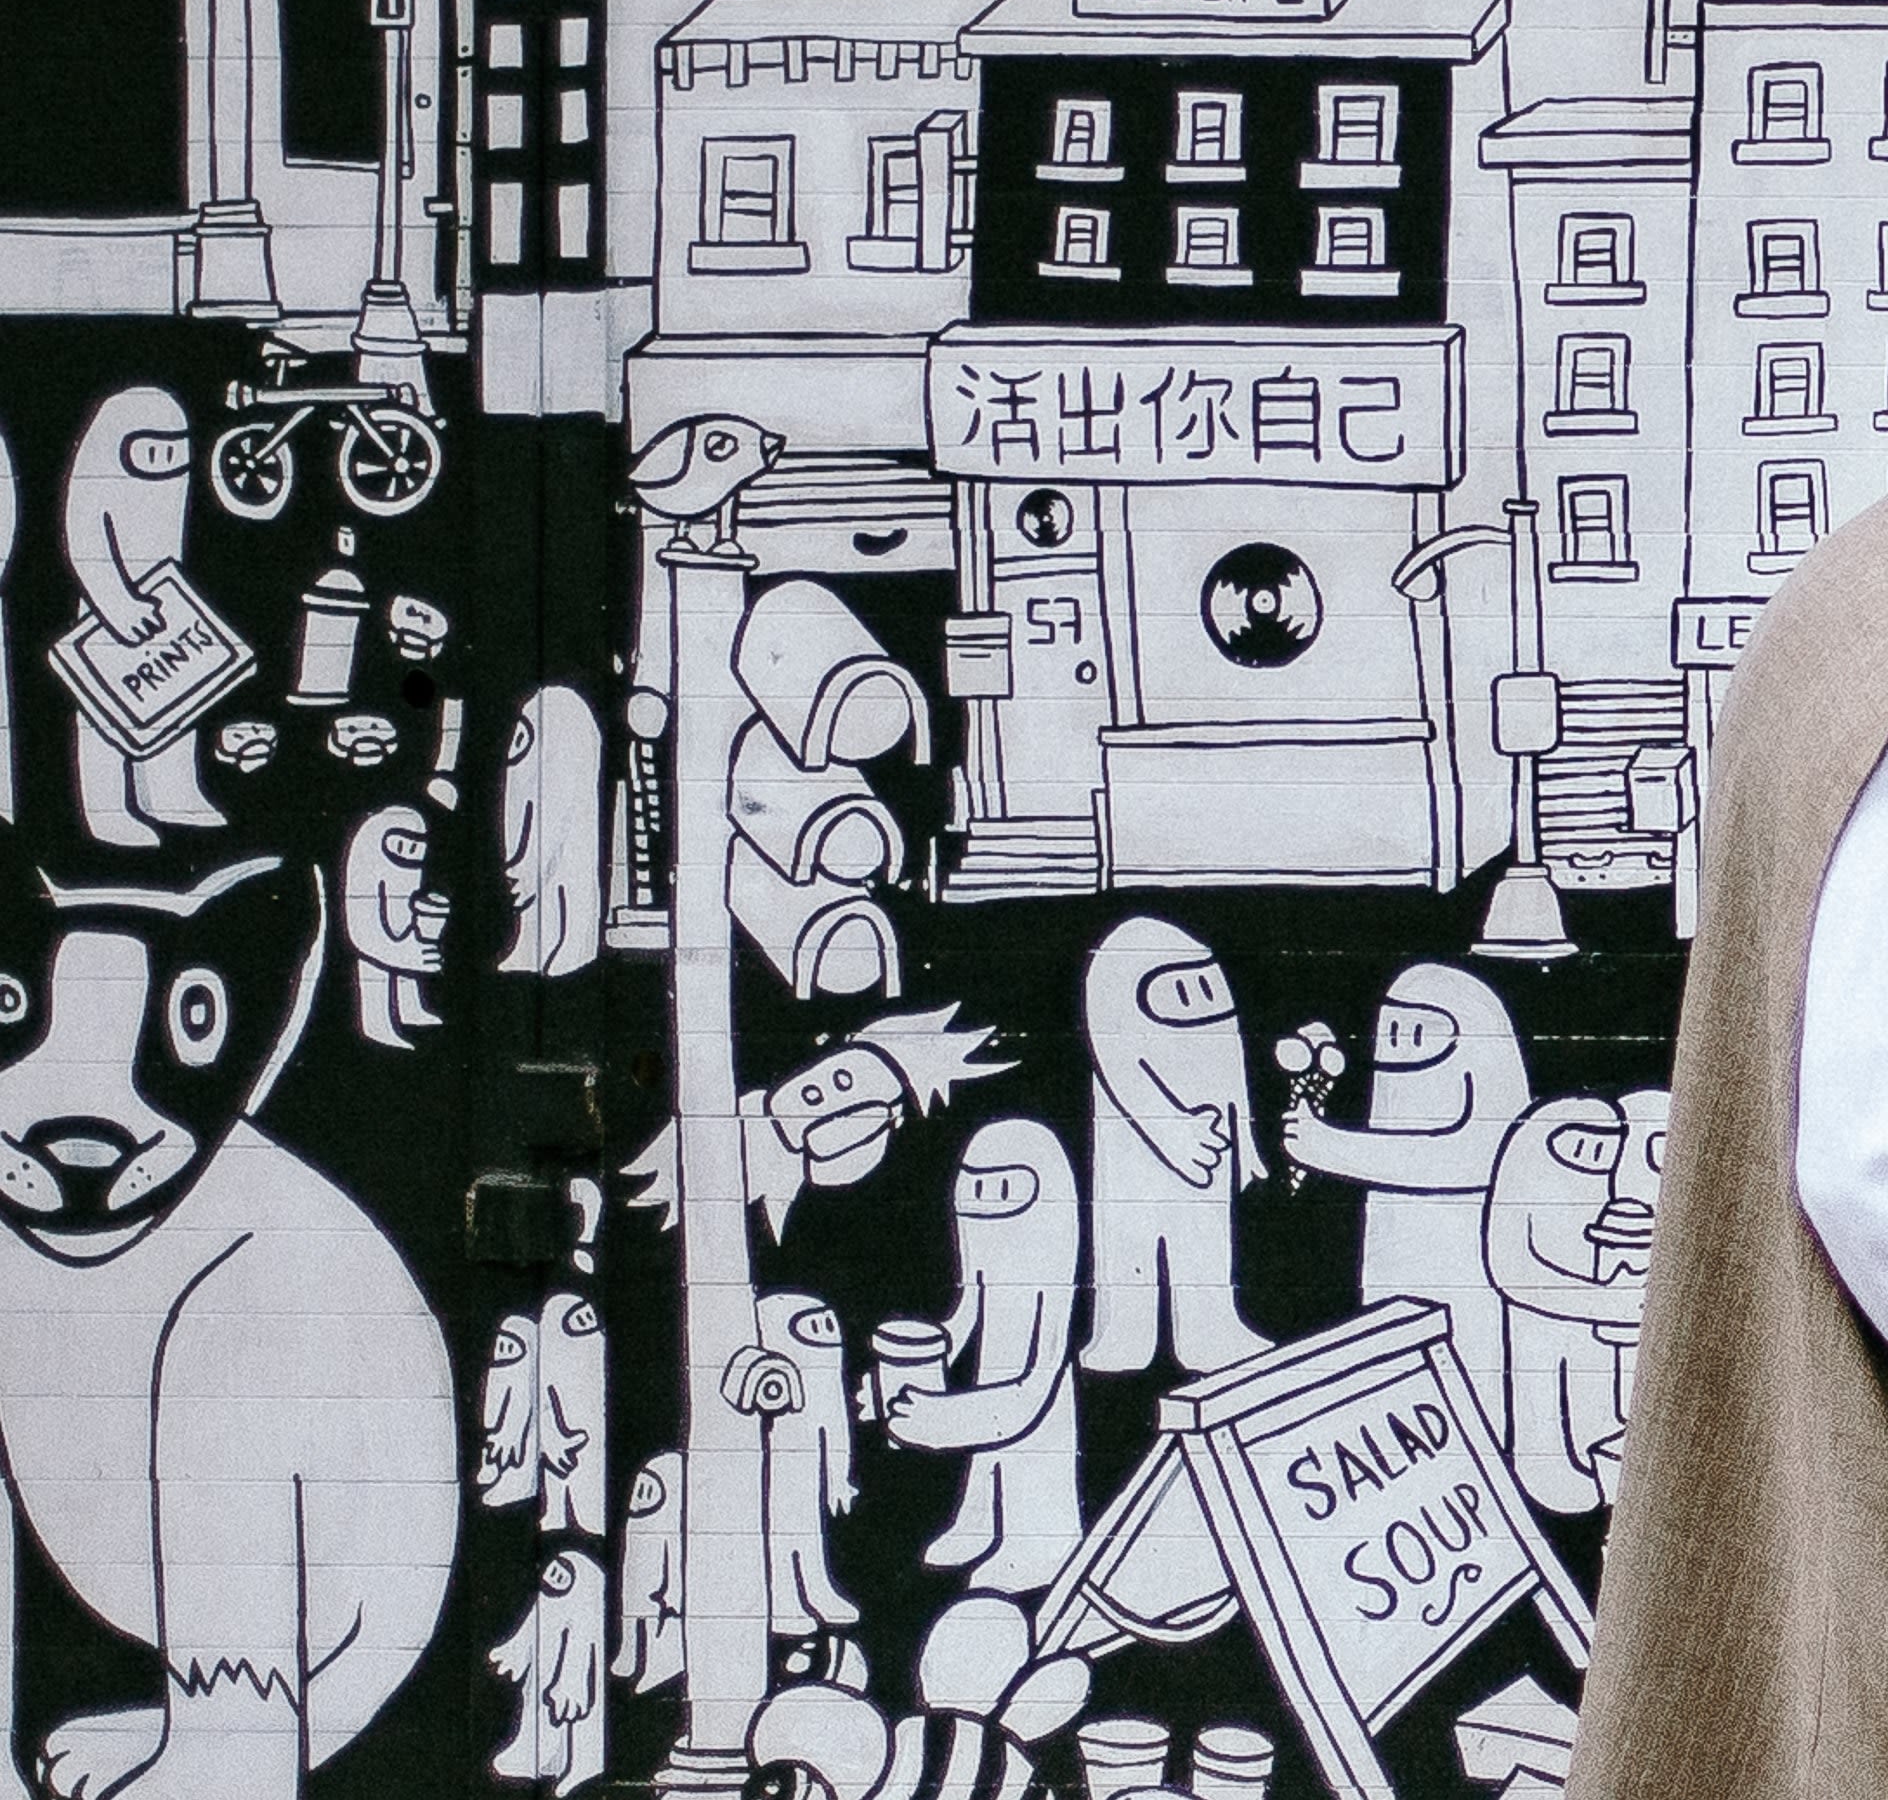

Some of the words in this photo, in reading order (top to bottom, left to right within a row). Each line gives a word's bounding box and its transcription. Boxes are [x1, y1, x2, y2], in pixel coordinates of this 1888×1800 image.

[956, 364, 1404, 466] 活出你自己
[1287, 1403, 1449, 1521] SALAD
[1344, 1483, 1488, 1621] SOUP
